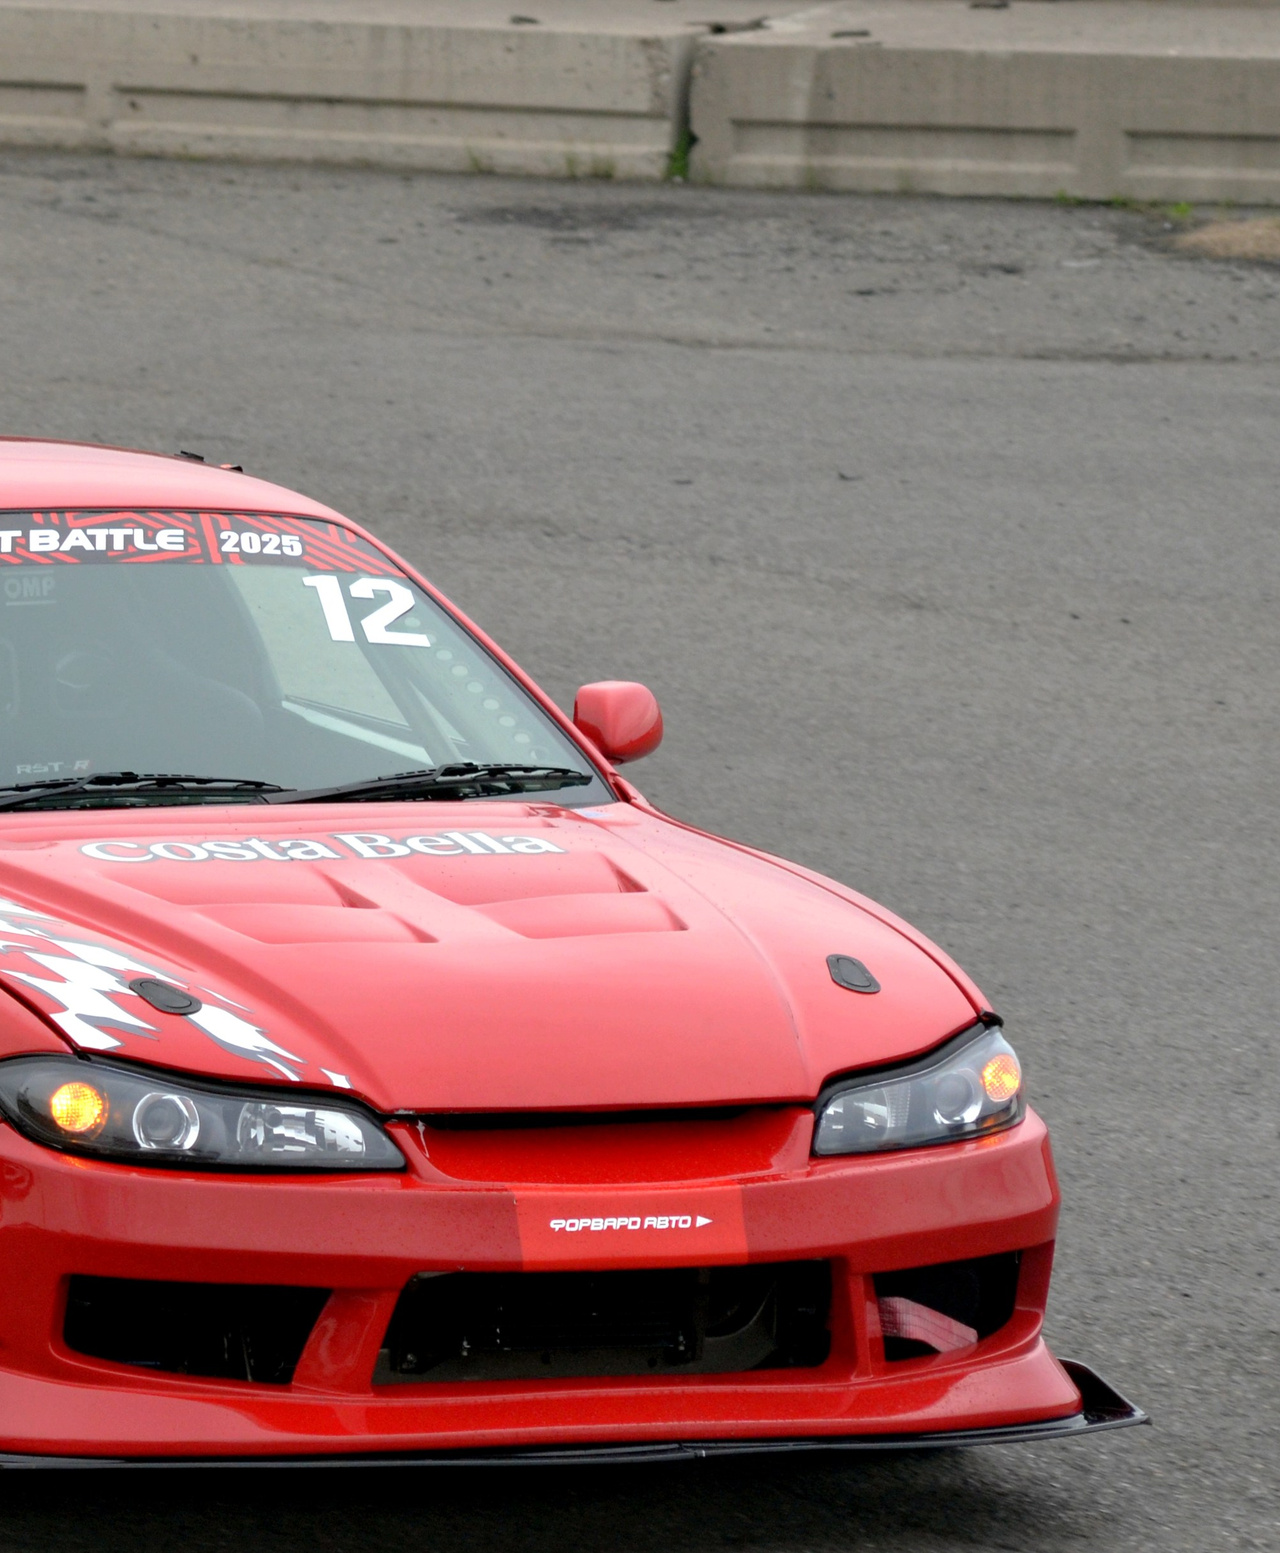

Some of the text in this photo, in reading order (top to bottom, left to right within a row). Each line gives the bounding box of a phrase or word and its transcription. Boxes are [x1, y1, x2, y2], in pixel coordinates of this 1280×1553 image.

[28, 528, 185, 552] BATTLE
[220, 531, 303, 557] 2025
[4, 576, 56, 599] OMP
[302, 575, 431, 648] 12
[80, 831, 566, 863] Costa Bella
